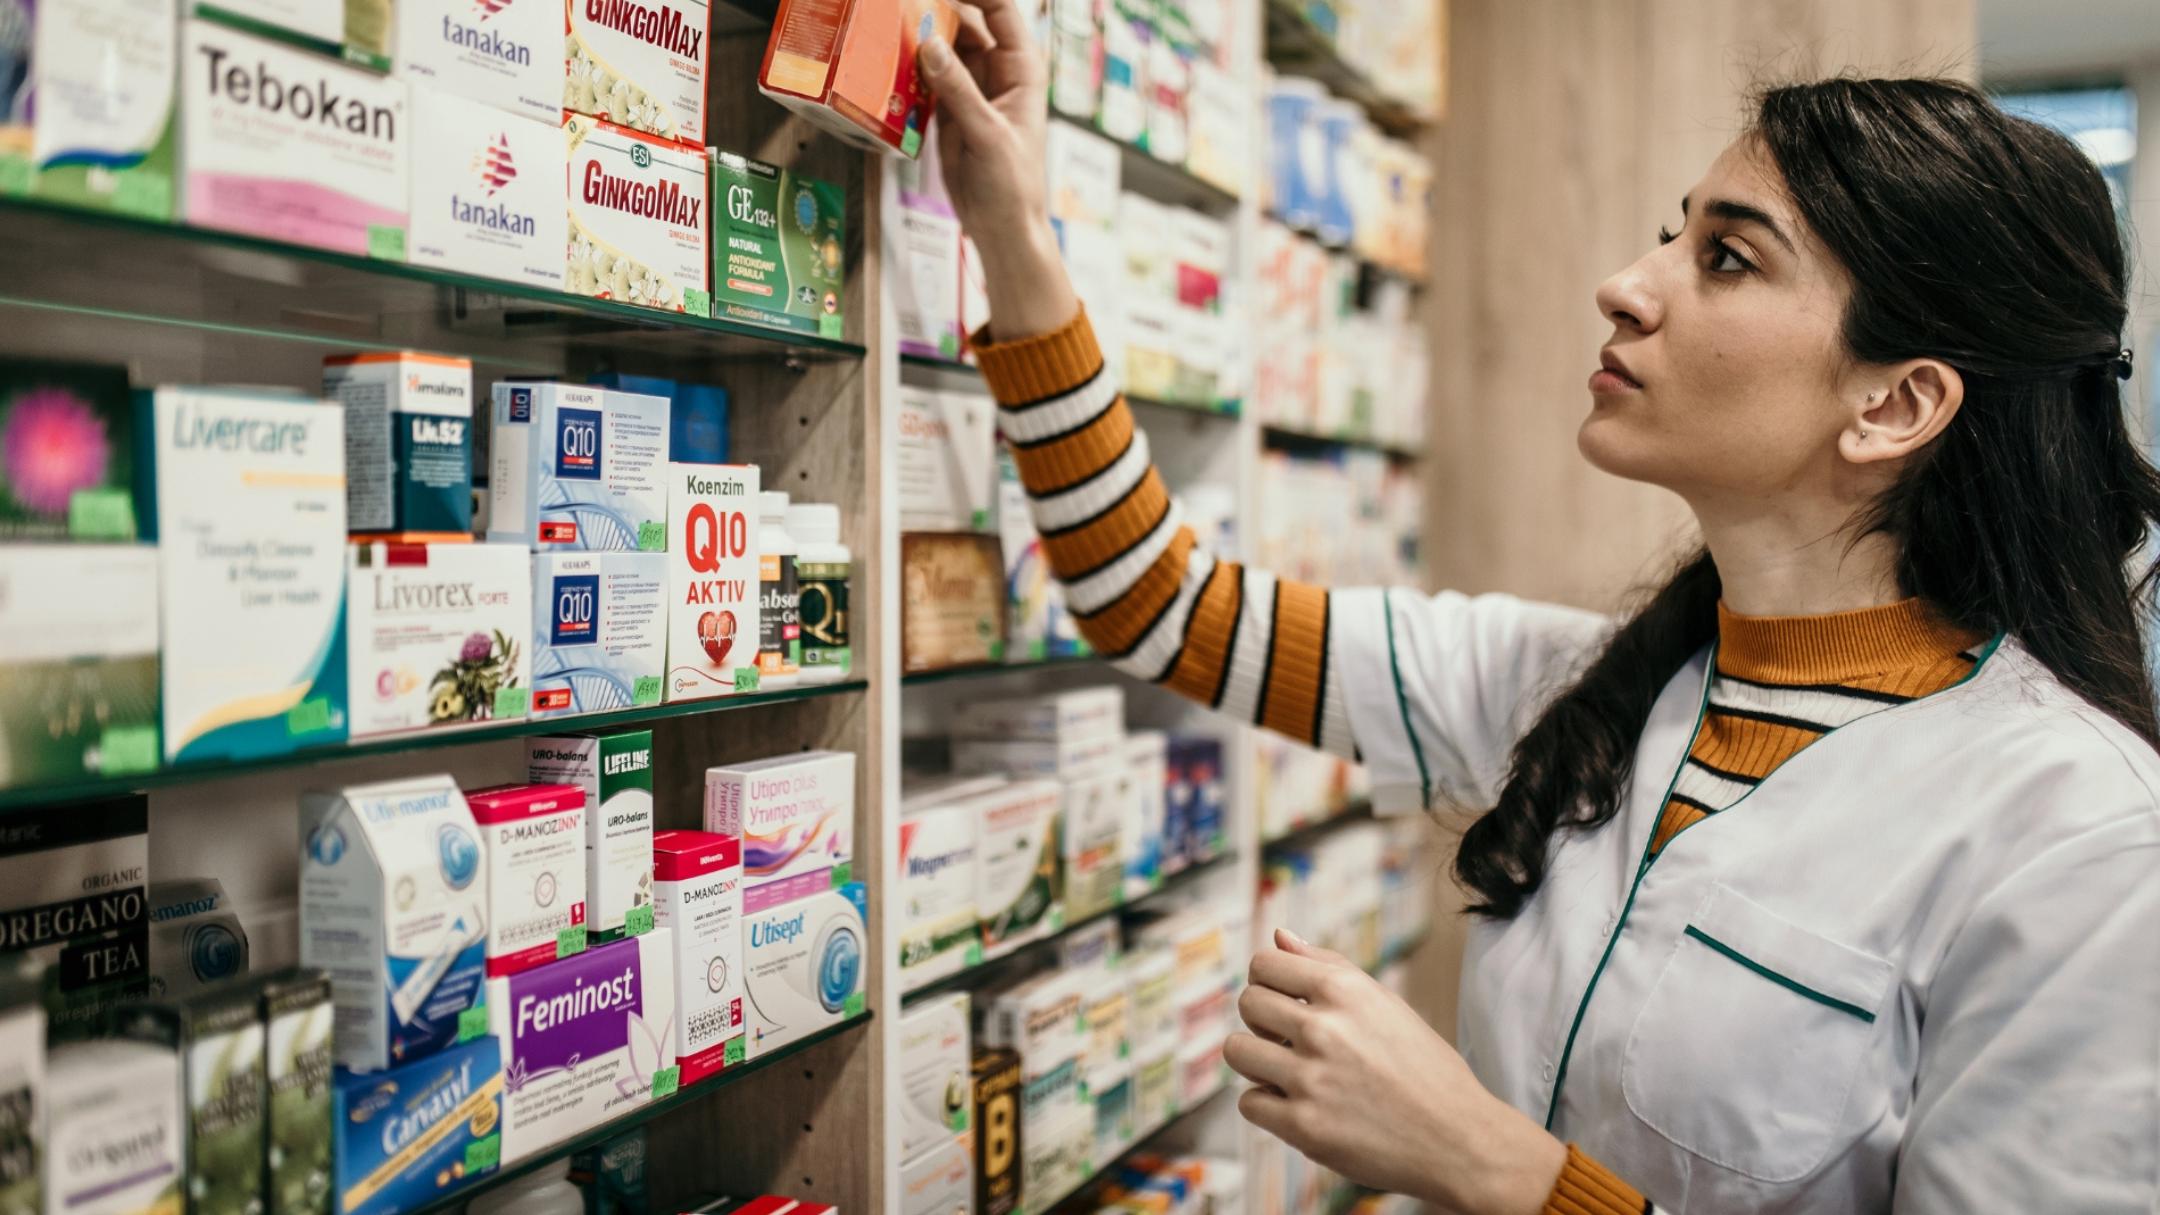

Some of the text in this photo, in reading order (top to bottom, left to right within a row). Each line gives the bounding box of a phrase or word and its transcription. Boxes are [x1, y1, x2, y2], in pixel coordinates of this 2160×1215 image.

[443, 15, 530, 67] tanakan
[197, 44, 395, 143] Tebokan
[632, 148, 650, 167] ESI
[452, 195, 536, 237] tanakan
[729, 236, 763, 255] NATURAL
[729, 254, 776, 273] ANTIOXIDANT
[729, 264, 765, 281] FORMULA
[173, 405, 307, 456] Livercare
[563, 426, 596, 457] Q10
[687, 475, 745, 496] Koenzim
[374, 574, 474, 611] Livorex
[559, 592, 592, 623] Q10
[686, 580, 746, 605] AKTIV
[532, 750, 589, 763] URO-balans
[605, 749, 650, 775] LIFELINE
[751, 779, 790, 801] Utipro
[500, 814, 578, 845] D-MANOZINN
[607, 812, 648, 828] URO-balans
[750, 803, 797, 826] Утипро
[83, 868, 142, 891] ORGANIC
[0, 893, 141, 947] REGANO
[751, 911, 804, 948] Utisept
[83, 943, 141, 980] TEA
[516, 967, 634, 1039] Feminost
[984, 1092, 1016, 1179] B
